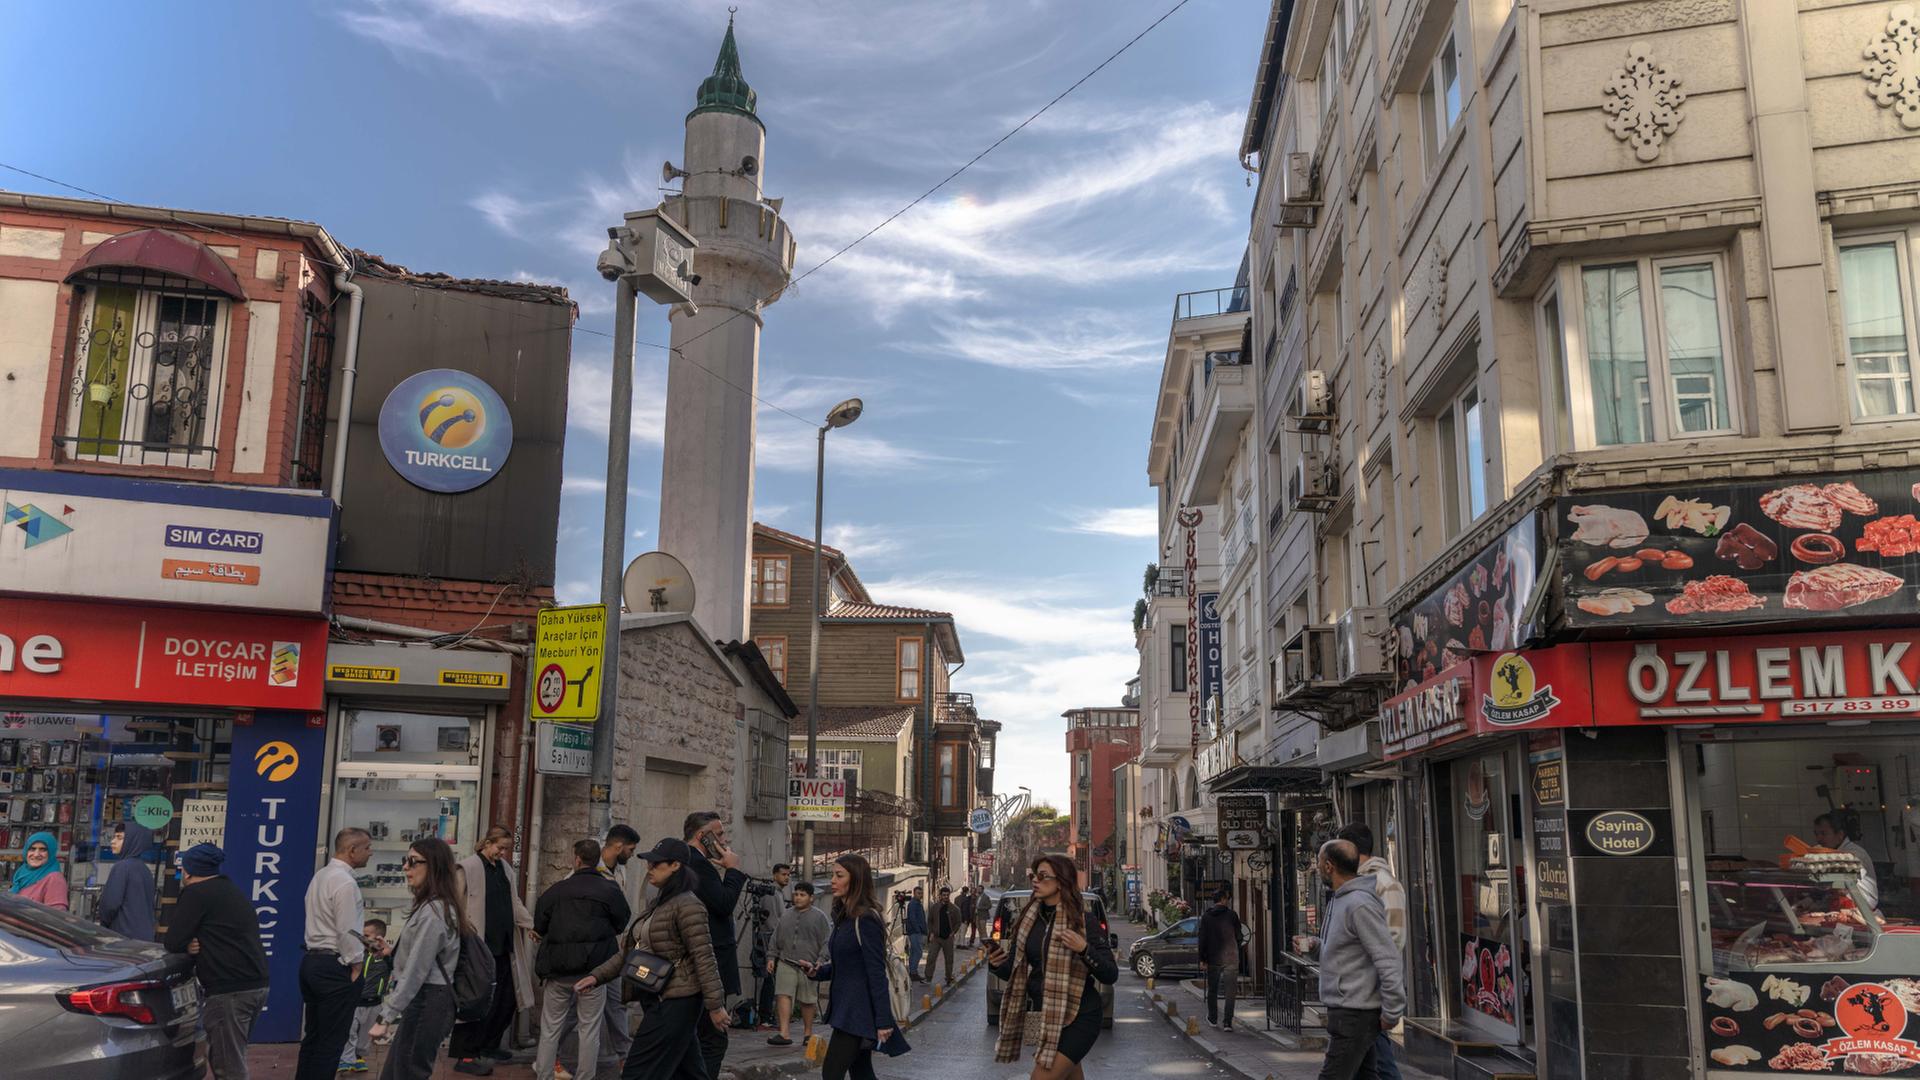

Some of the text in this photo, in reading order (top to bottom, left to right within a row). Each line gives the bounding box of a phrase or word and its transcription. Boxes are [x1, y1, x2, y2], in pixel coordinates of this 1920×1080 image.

[405, 450, 492, 472] TURKCELL
[169, 528, 260, 549] SIM CARD
[175, 562, 247, 582] بطاقة سيم
[541, 612, 603, 626] Daha Yüksek
[542, 626, 598, 643] Araçlar İçin
[164, 637, 266, 662] DOYCAR
[540, 645, 599, 658] Mecburi Yön
[1184, 529, 1201, 761] KUMLUK KONAK HOTEL
[175, 658, 257, 682] İLETİŞİM
[1208, 630, 1220, 695] HOTE
[1628, 641, 1920, 703] ÖZLEM K
[542, 677, 552, 699] 2
[1415, 677, 1460, 733] KASAP
[1512, 704, 1540, 719] KASAP
[1792, 698, 1910, 713] 517 83 89
[28, 716, 76, 726] HUAWEI
[802, 781, 832, 798] WC
[186, 804, 226, 812] TRAVEL
[794, 798, 837, 806] TOILET
[194, 815, 215, 823] SIM
[1226, 809, 1257, 818] SUITES
[184, 827, 223, 836] TRAVEL
[1221, 820, 1264, 829] OLD CITY
[1596, 819, 1644, 834] Sayina
[1602, 837, 1640, 849] Hotel
[1537, 861, 1568, 884] Gloria
[251, 797, 286, 1011] TURKCE
[1839, 1040, 1907, 1054] ÖZLEM KASAP
